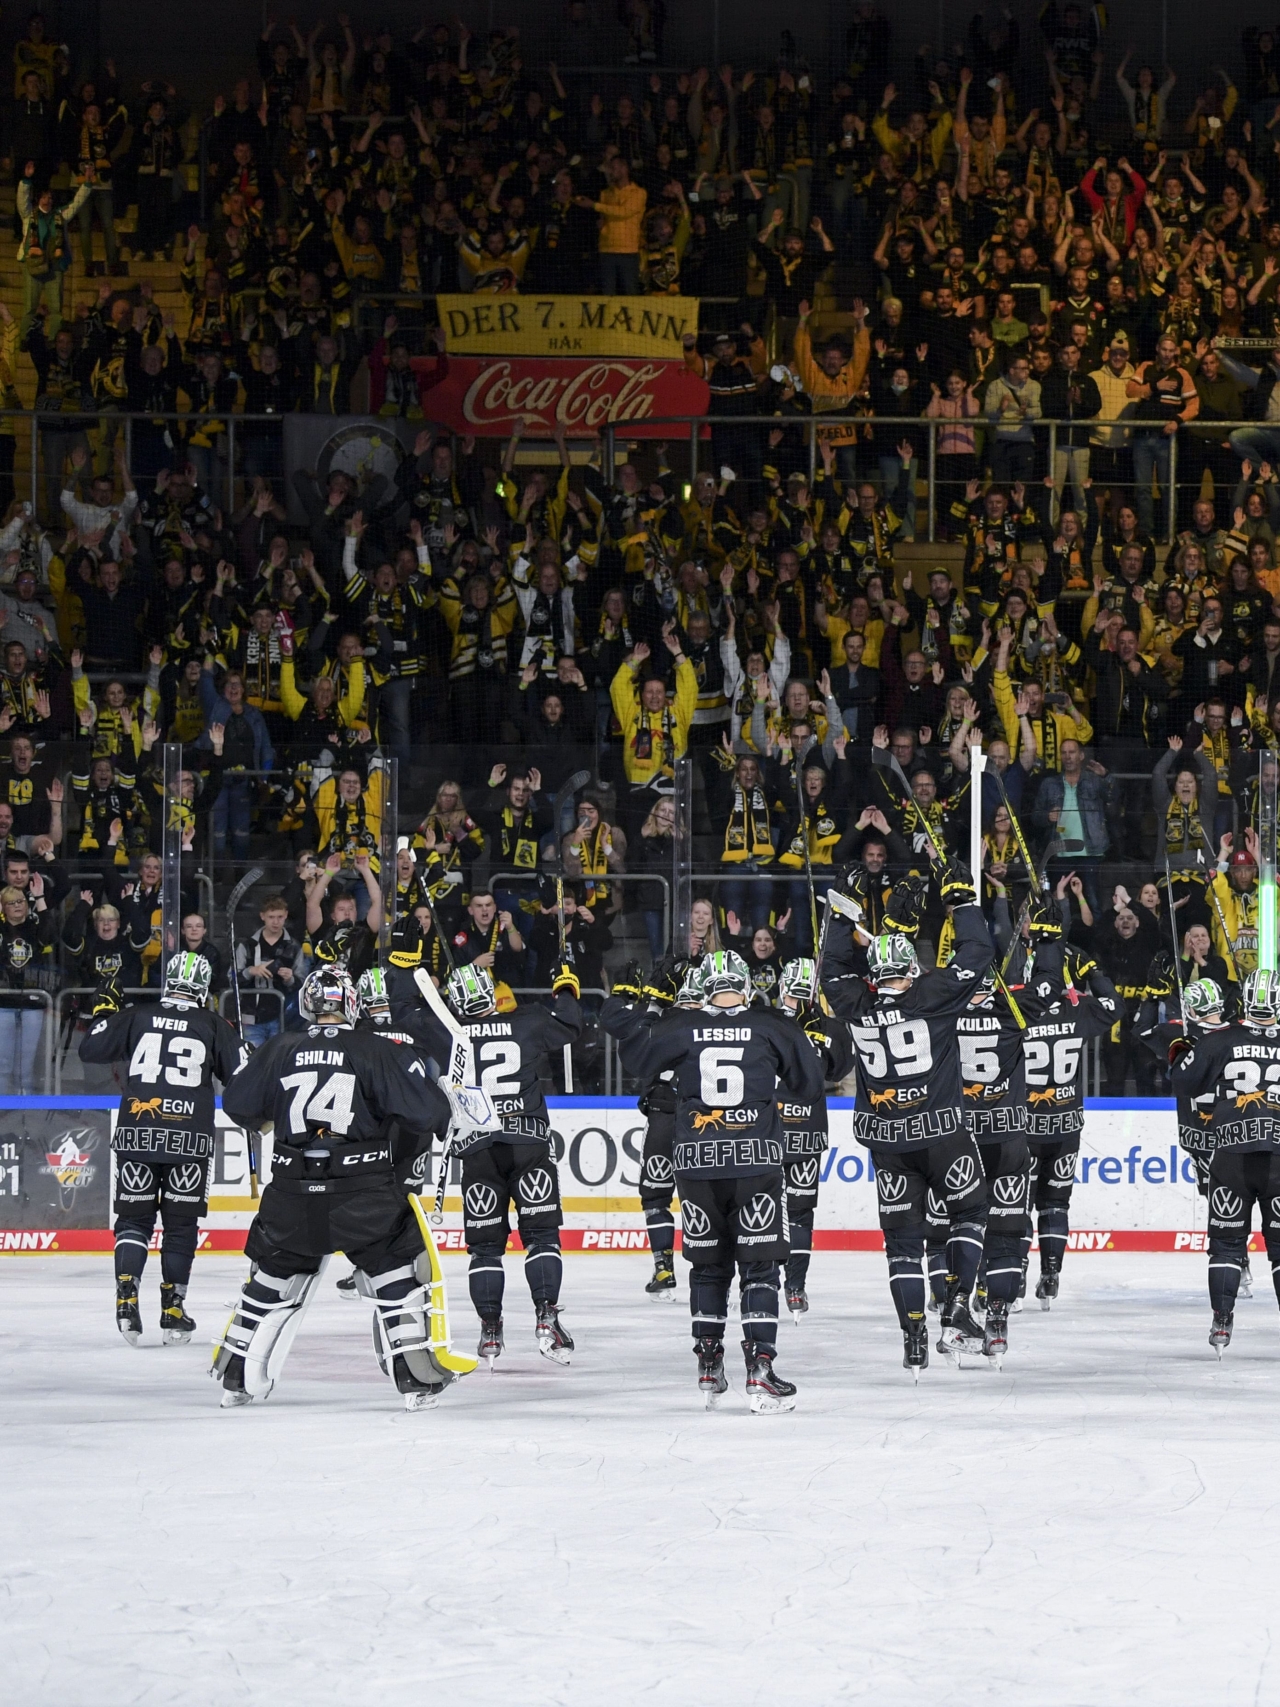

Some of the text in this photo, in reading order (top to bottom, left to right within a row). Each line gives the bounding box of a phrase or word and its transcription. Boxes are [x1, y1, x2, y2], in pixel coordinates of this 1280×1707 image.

[446, 301, 688, 342] DER 7. MANN
[548, 336, 583, 350] HAK
[463, 361, 668, 426] Coca-Cola
[463, 1022, 512, 1036] BRAUN
[692, 1027, 751, 1042] LESSIO
[956, 1016, 1001, 1032] KULDA
[129, 1032, 206, 1087] 43
[295, 1050, 344, 1067] SHILIN
[850, 1018, 934, 1079] 59
[1023, 1037, 1084, 1086] 26
[699, 1046, 745, 1107] 6
[162, 1098, 195, 1115] EGN
[280, 1071, 356, 1135] 74
[783, 1103, 812, 1117] EGN
[725, 1108, 759, 1124] EGN
[853, 1107, 958, 1143] KREFELD
[111, 1126, 210, 1158] KREFELD
[342, 1149, 389, 1165] CCM
[672, 1138, 783, 1173] KREFELD
[308, 1184, 326, 1193] axis
